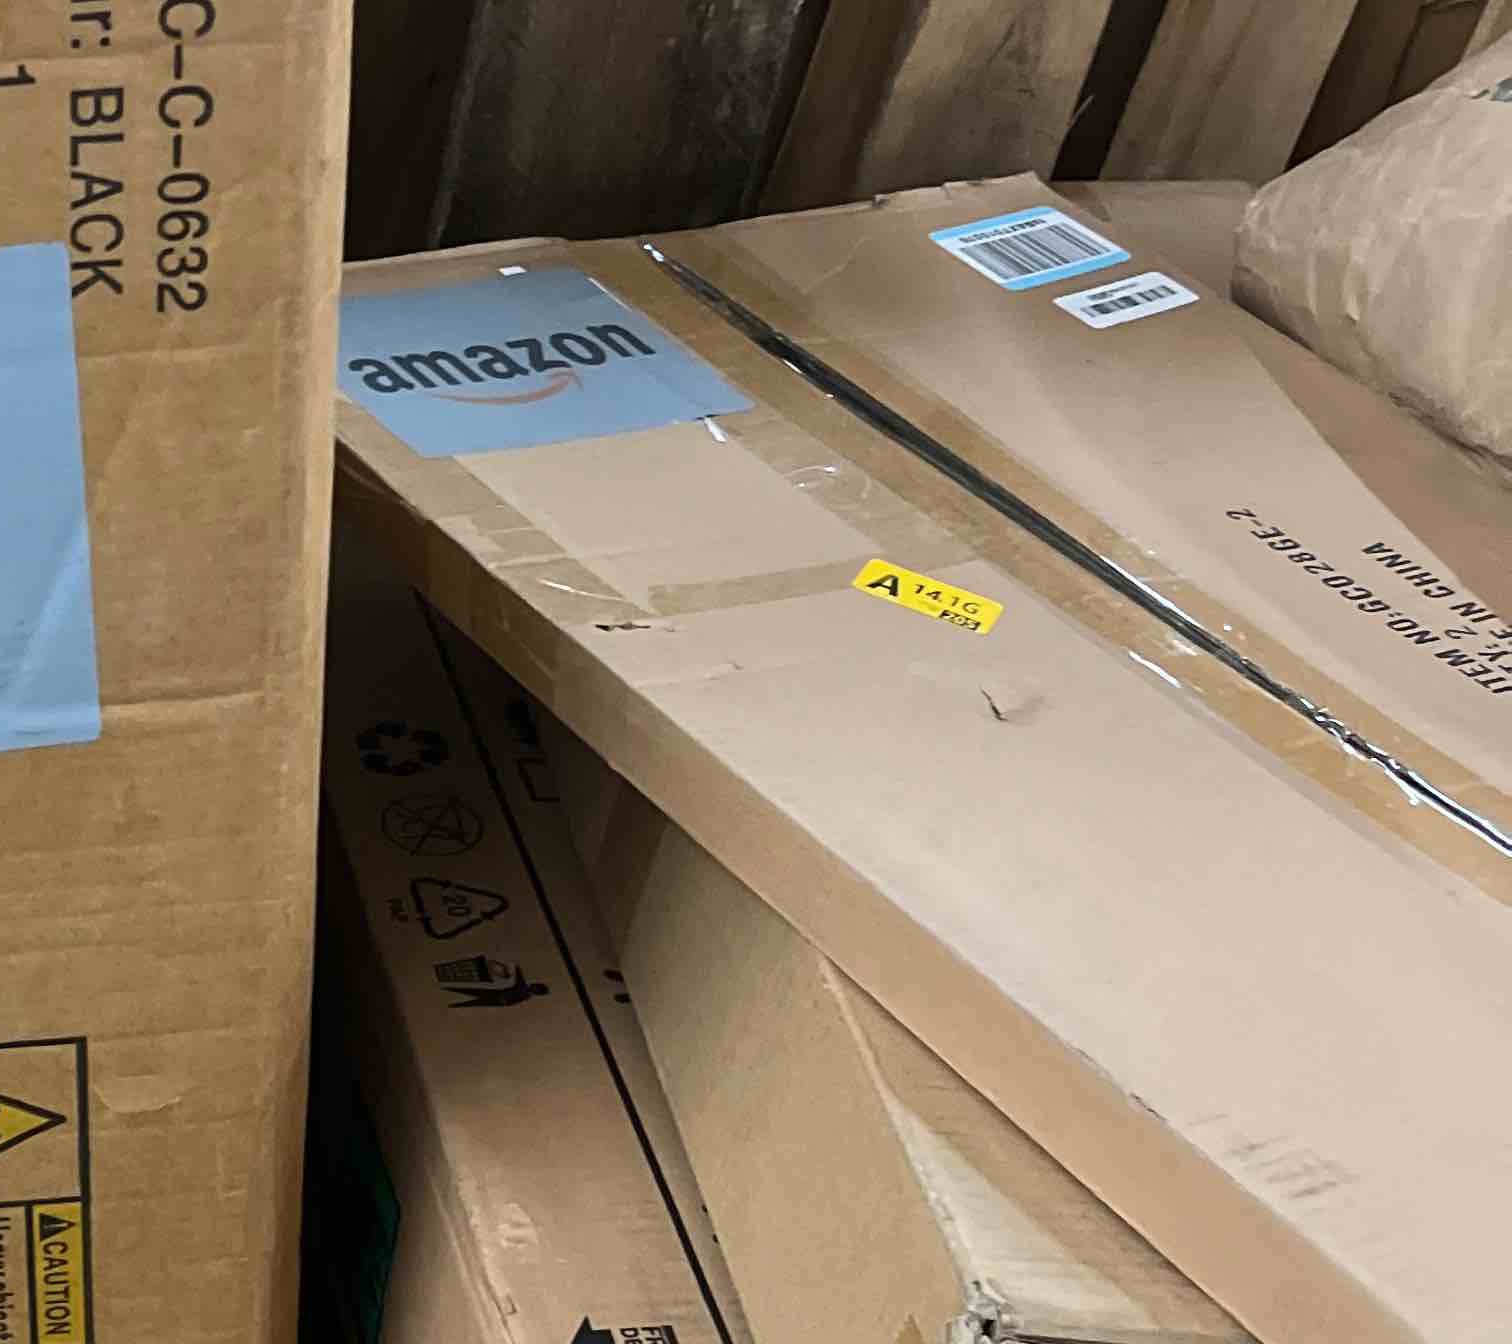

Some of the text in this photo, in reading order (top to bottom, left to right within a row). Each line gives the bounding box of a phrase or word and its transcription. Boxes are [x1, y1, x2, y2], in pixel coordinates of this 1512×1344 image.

[69, 86, 125, 297] BLACK
[348, 323, 656, 394] amazon
[865, 573, 900, 597] A
[1361, 542, 1498, 624] IN CHINA
[1444, 625, 1478, 640] 2
[1433, 648, 1512, 694] ITEM
[41, 1240, 72, 1337] CAUTION
